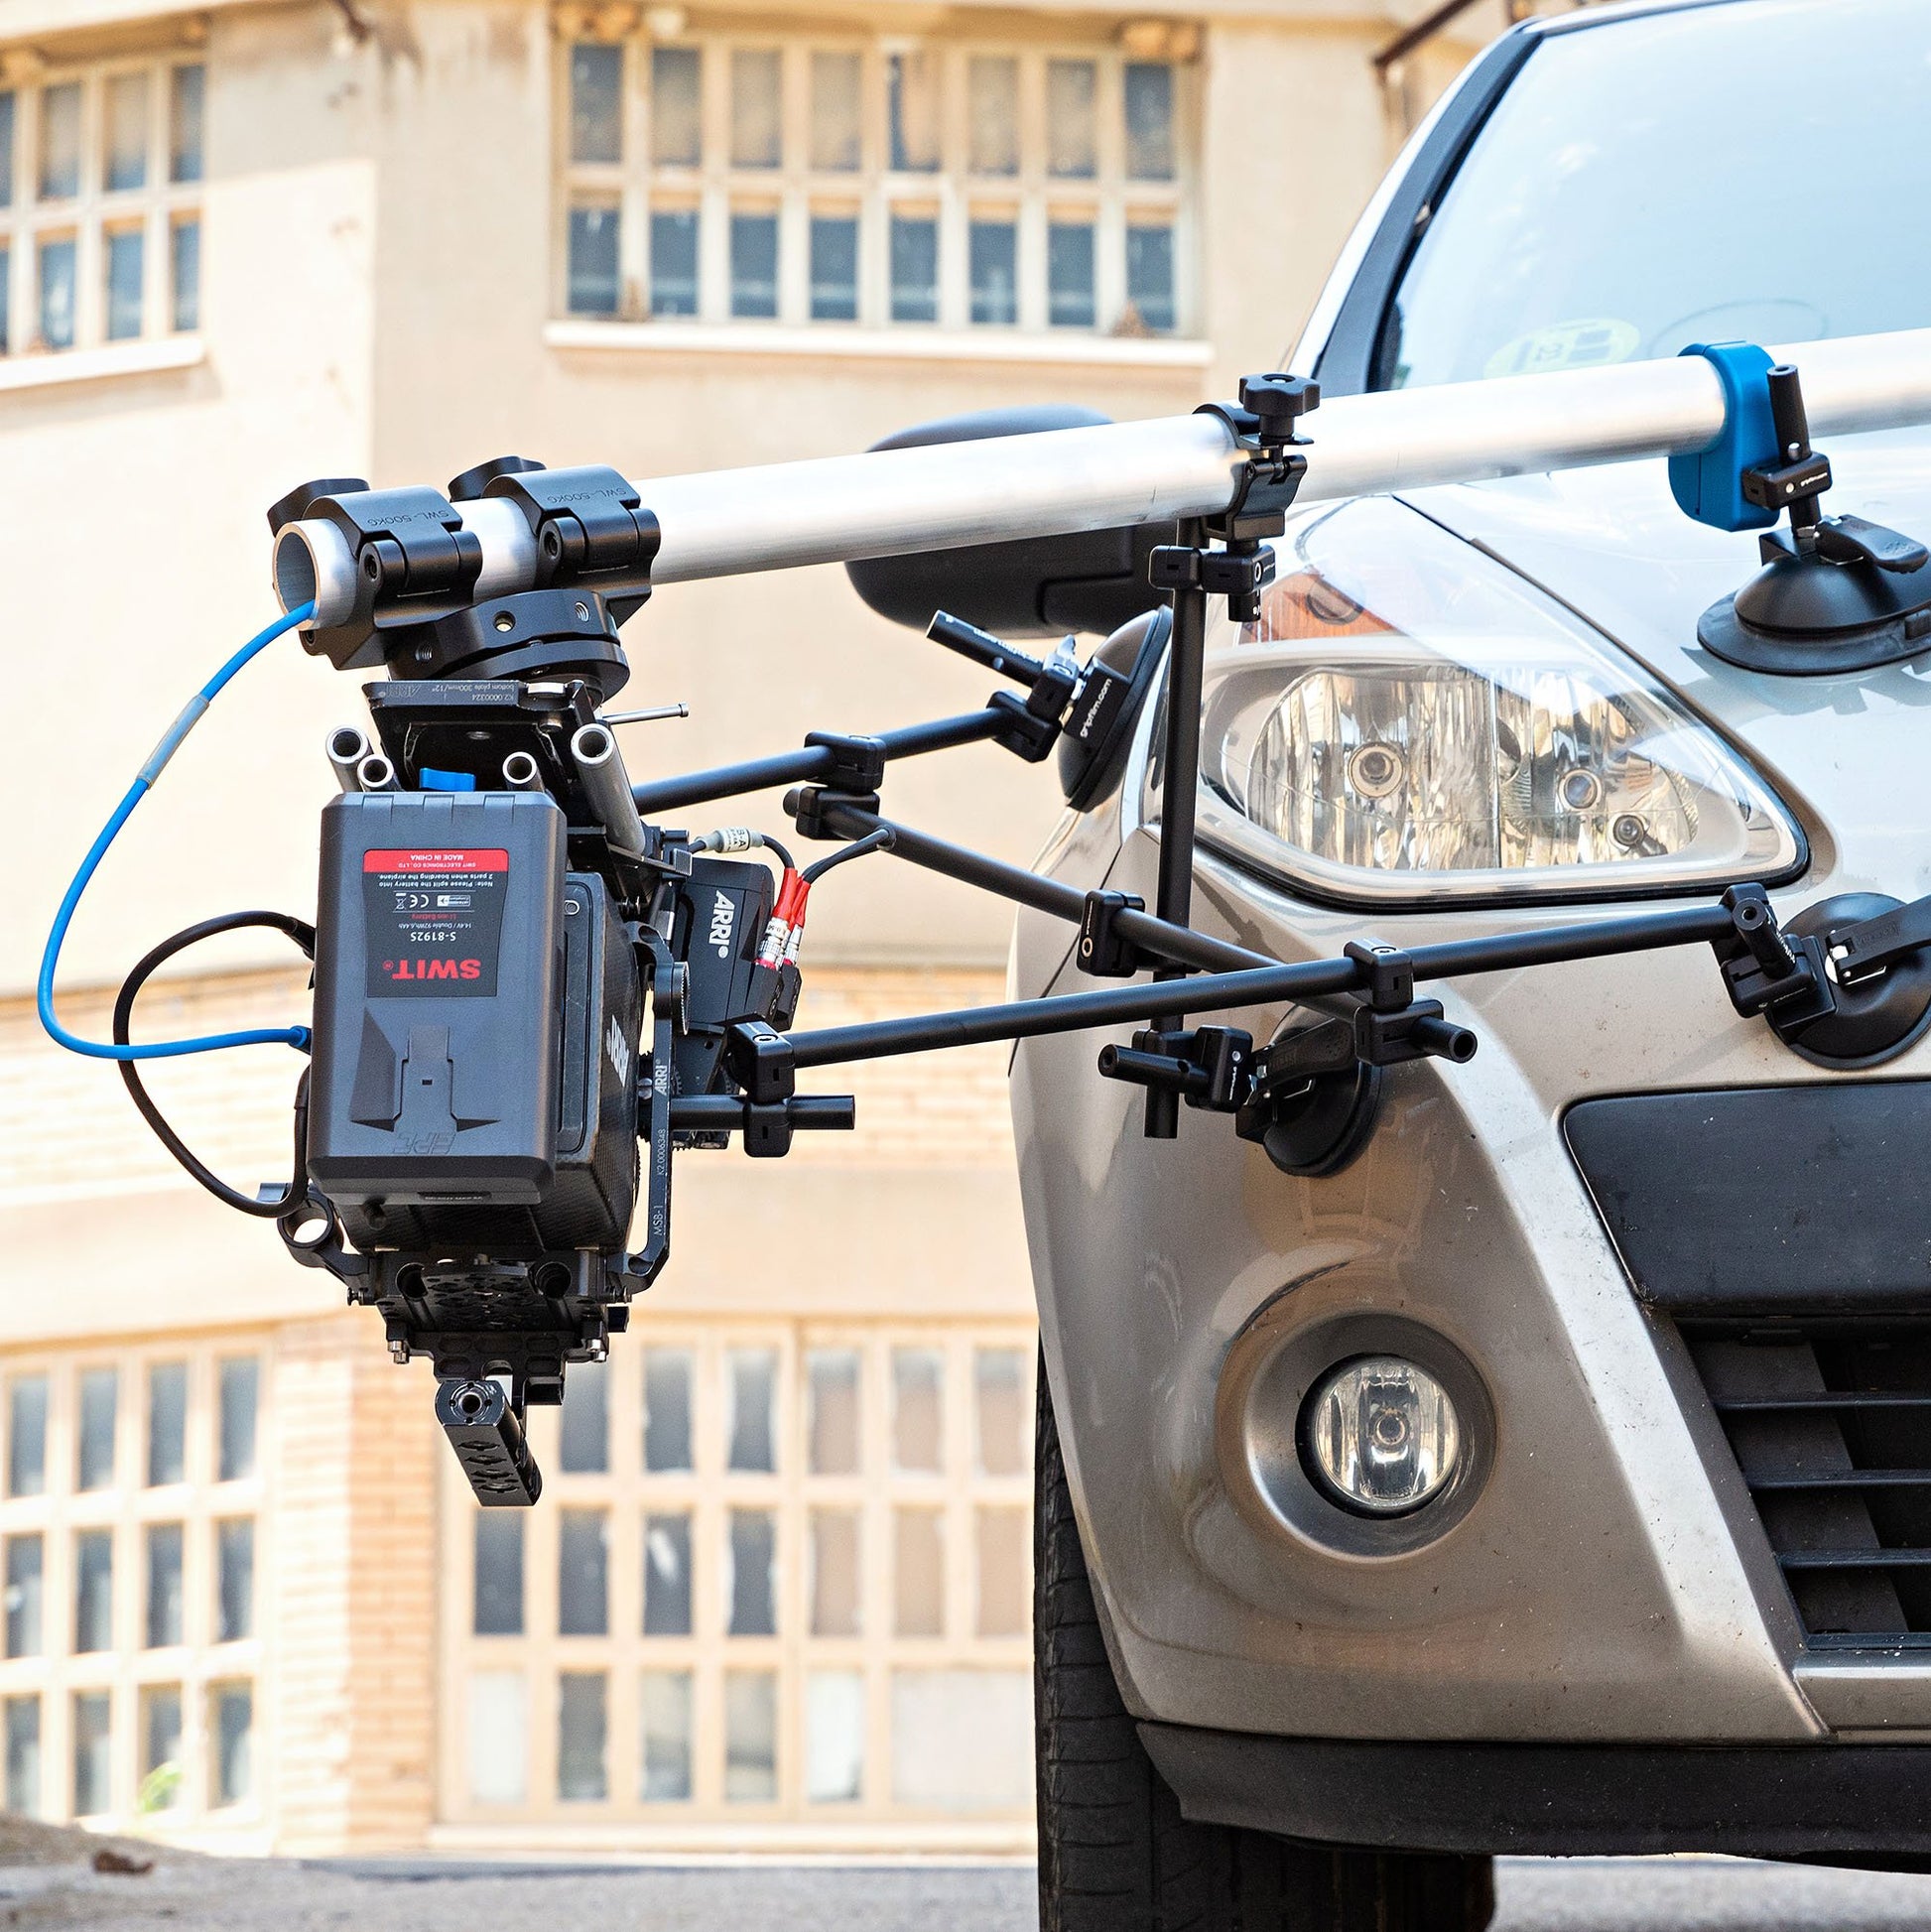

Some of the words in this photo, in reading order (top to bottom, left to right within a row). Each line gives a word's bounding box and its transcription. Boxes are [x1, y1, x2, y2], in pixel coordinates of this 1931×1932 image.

[366, 509, 450, 527] SWL-500KG
[473, 683, 490, 692] plate
[1080, 678, 1112, 738] gripfilm.com
[708, 890, 735, 946] ARRI
[410, 931, 456, 941] S-8192S
[654, 1065, 668, 1096] ARRI
[653, 1204, 665, 1236] MSB-1
